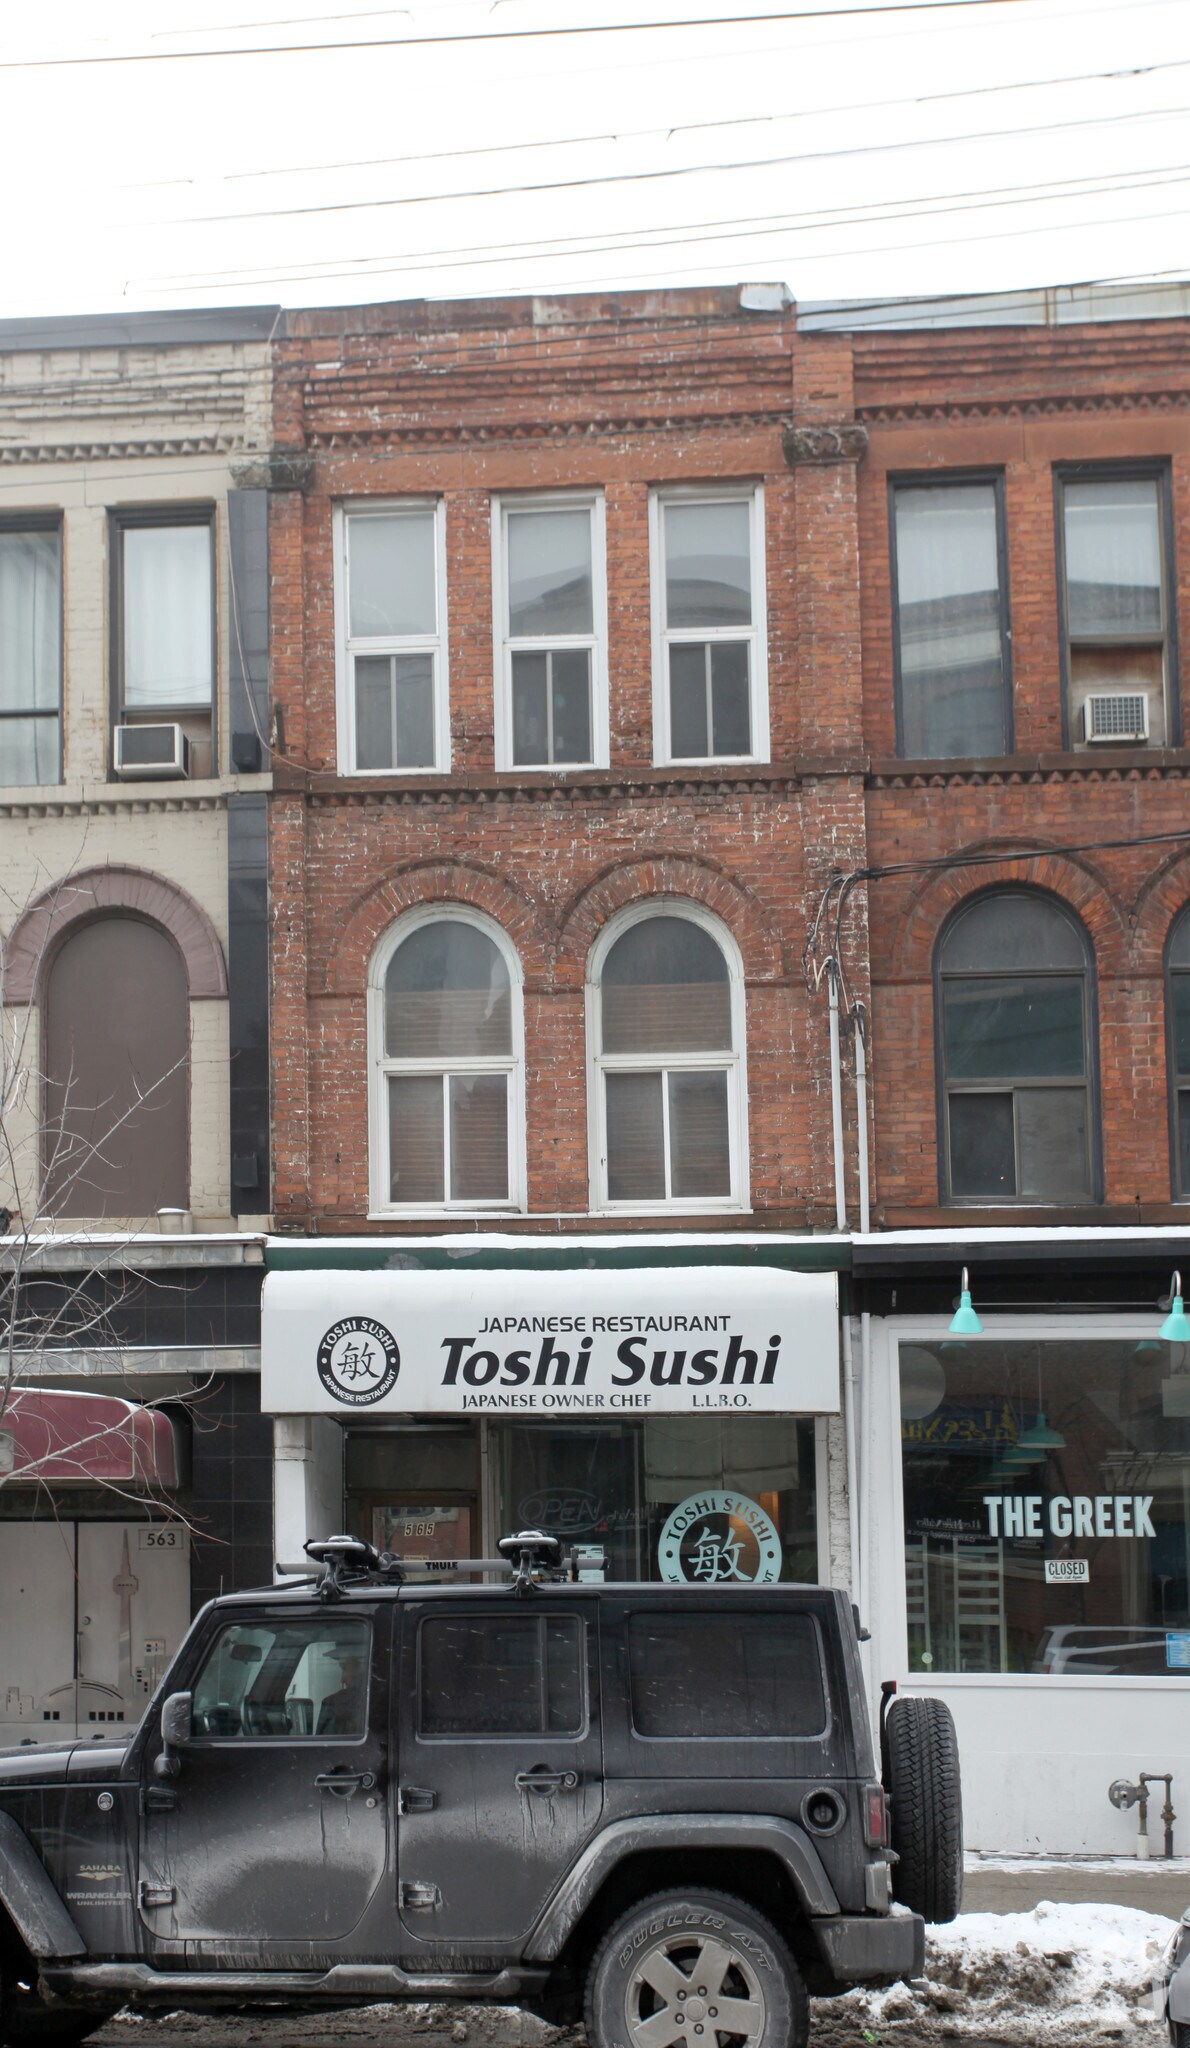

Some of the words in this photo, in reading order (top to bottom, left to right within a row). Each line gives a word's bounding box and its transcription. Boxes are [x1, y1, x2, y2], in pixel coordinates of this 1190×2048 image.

[321, 1320, 357, 1351] TOSHI
[360, 1320, 396, 1351] SUSHI
[478, 1316, 586, 1333] JAPANESE
[592, 1315, 732, 1332] RESTAURANT
[336, 1341, 381, 1382] 敏
[440, 1336, 594, 1387] Toshi
[611, 1334, 782, 1387] Sushi
[322, 1373, 355, 1402] JAPANESE
[355, 1368, 396, 1402] RESTAURANT
[462, 1394, 537, 1409] JAPANESE
[541, 1394, 605, 1407] OWNER
[609, 1394, 652, 1407] CHEF
[692, 1393, 752, 1407] L.L.B.O.
[521, 1499, 601, 1521] OPEN
[666, 1497, 717, 1541] TOSHI
[723, 1497, 773, 1542] SUSHI
[983, 1496, 1044, 1538] THE
[1048, 1496, 1158, 1538] GREEK
[147, 1532, 176, 1546] 563
[404, 1523, 434, 1536] 565
[425, 1562, 459, 1571] THULE
[687, 1526, 754, 1583] 敏
[1048, 1562, 1085, 1576] CLOSED
[66, 1892, 132, 1900] WRANGLER
[619, 1913, 726, 1969] DUELER
[730, 1932, 773, 1972] A/T
